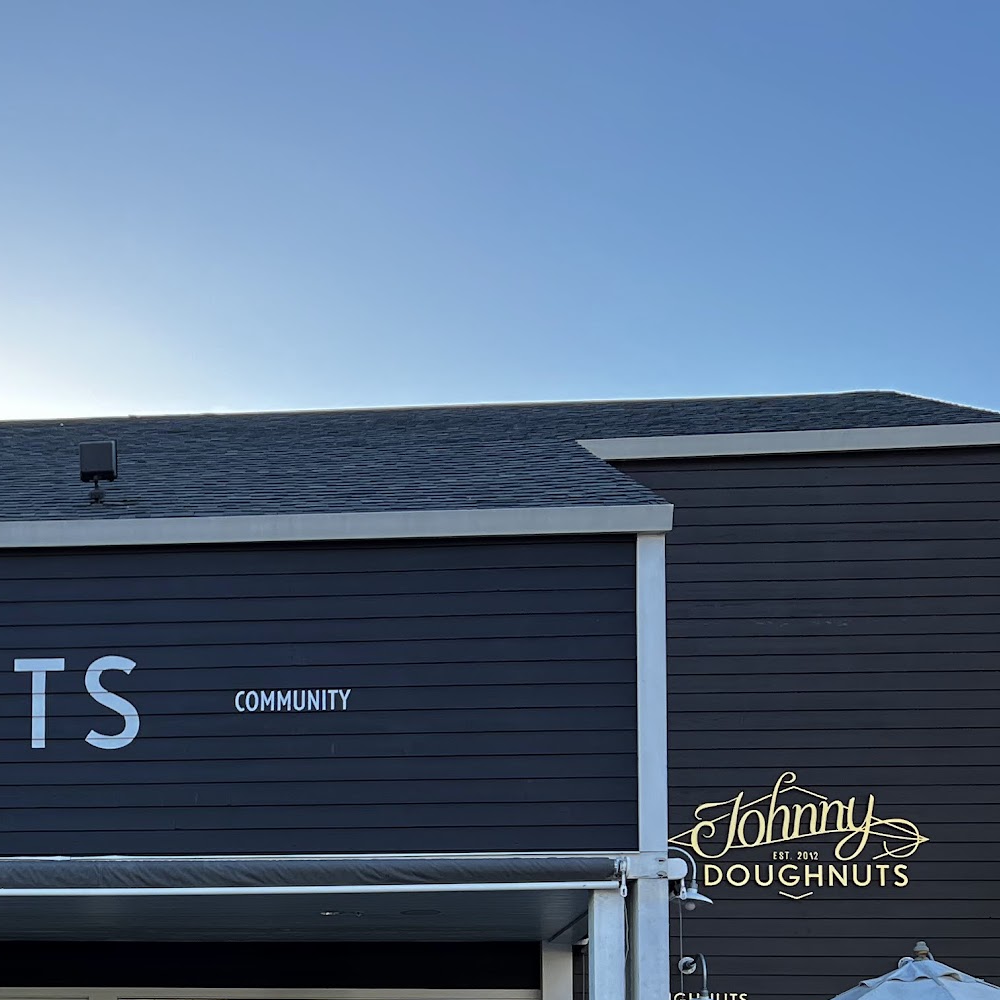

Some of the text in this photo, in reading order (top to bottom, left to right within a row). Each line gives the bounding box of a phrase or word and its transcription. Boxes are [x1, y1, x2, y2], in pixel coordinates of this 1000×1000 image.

[234, 688, 352, 712] COMMUNITY
[691, 771, 884, 861] Johnny
[797, 851, 819, 861] 2012
[704, 863, 909, 887] DOUGHNUTS
